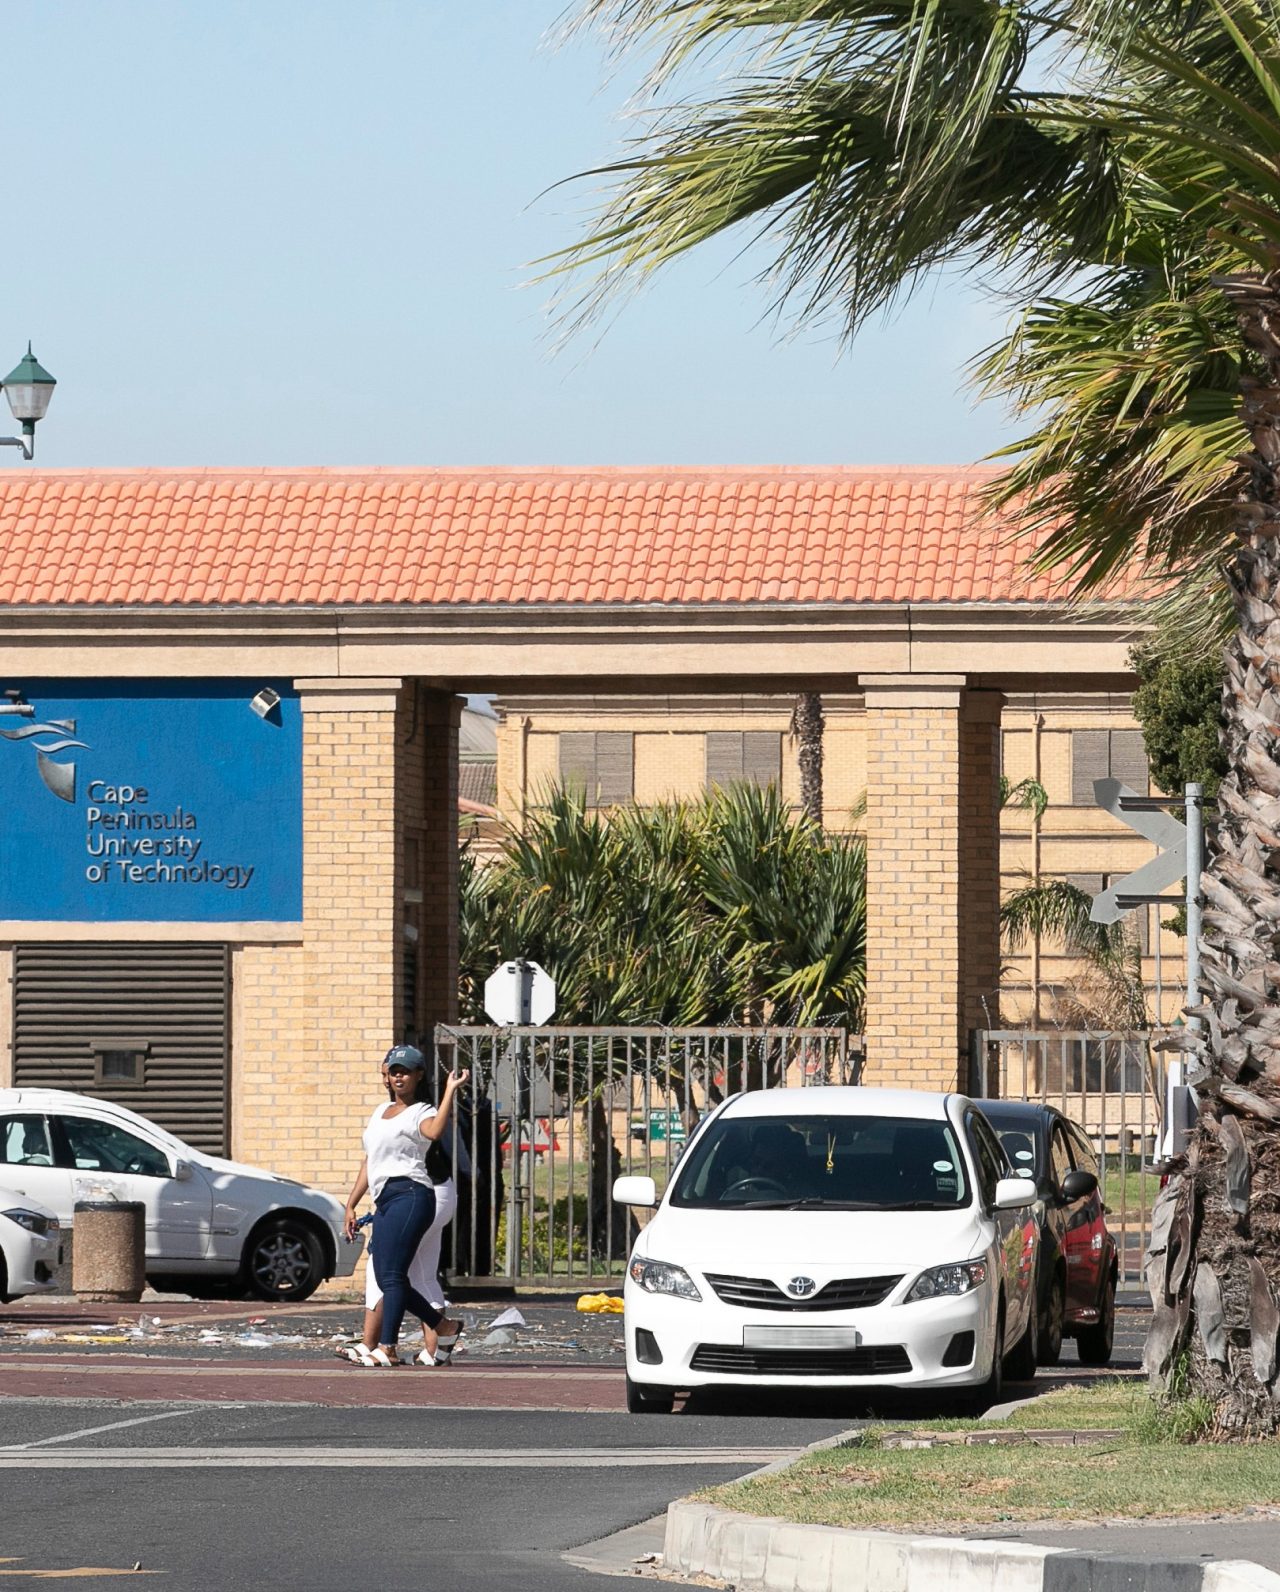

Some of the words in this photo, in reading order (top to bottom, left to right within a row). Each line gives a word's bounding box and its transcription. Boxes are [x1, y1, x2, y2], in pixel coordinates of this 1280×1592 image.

[87, 780, 149, 810] Cape
[87, 806, 197, 830] Peninsula
[86, 833, 202, 862] University
[86, 860, 112, 883] of
[117, 859, 255, 889] Technology
